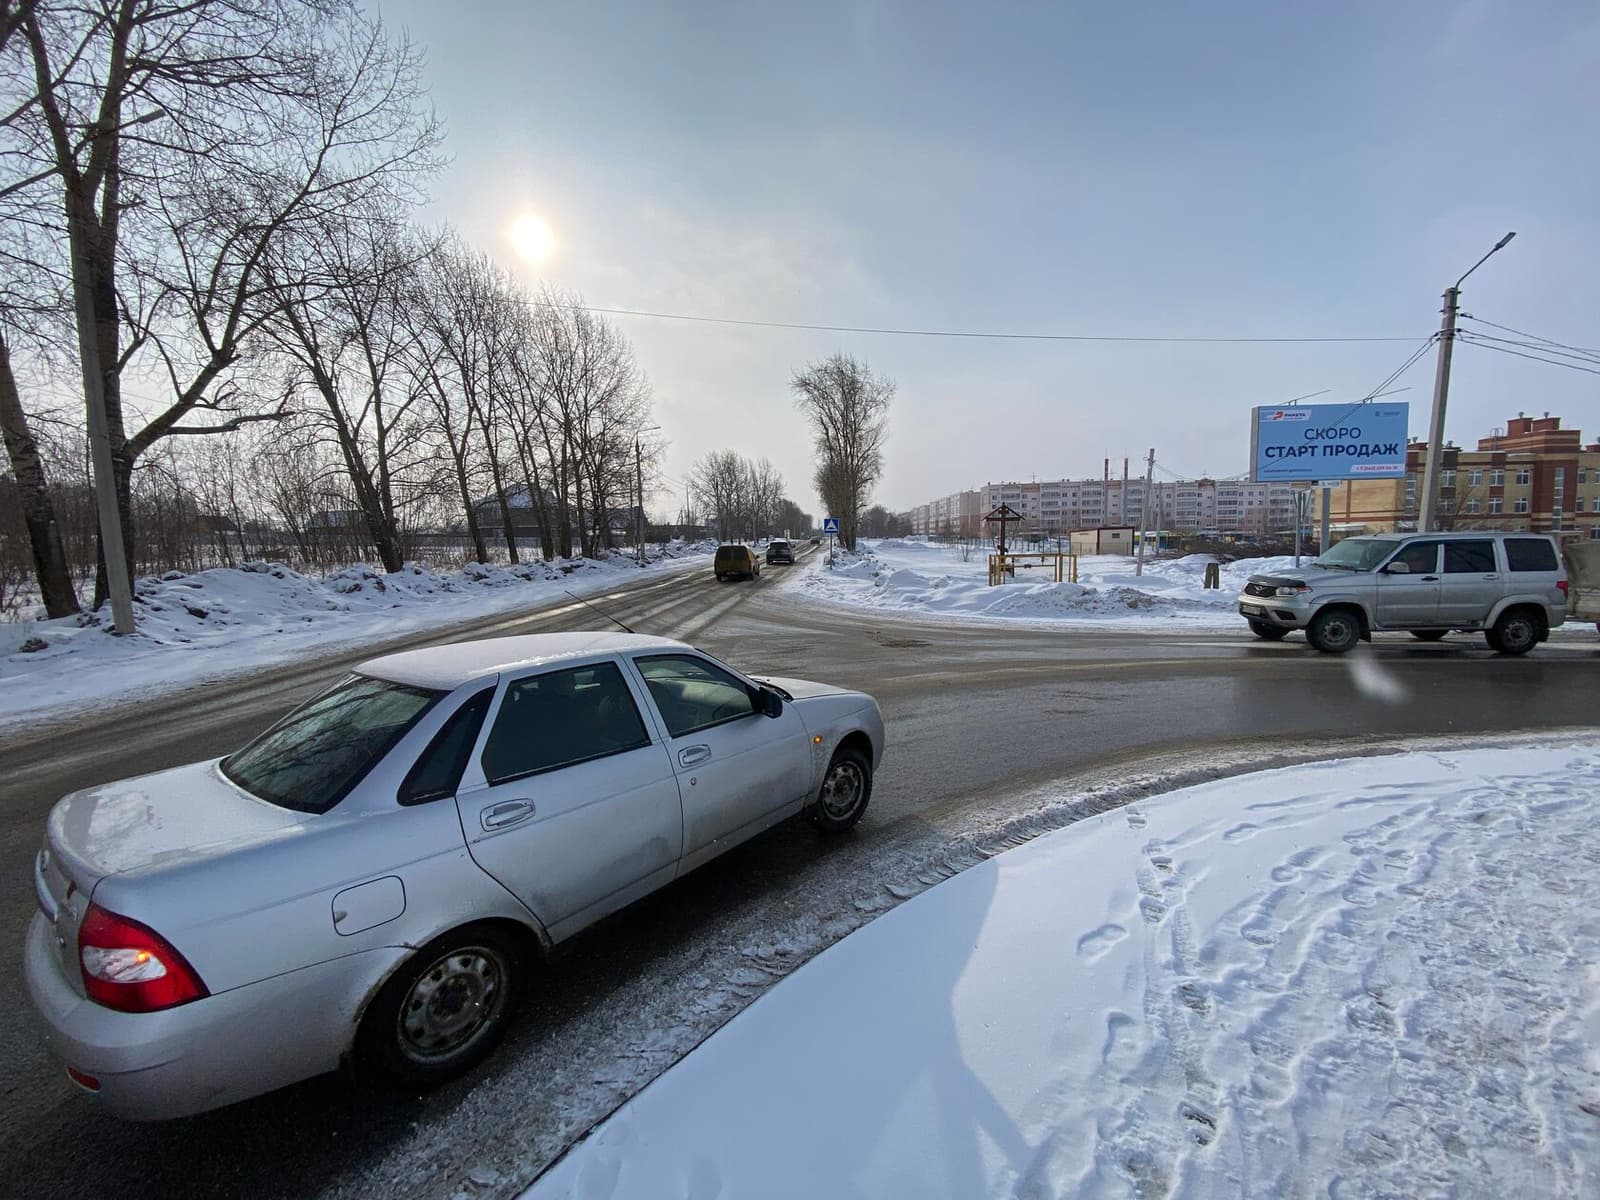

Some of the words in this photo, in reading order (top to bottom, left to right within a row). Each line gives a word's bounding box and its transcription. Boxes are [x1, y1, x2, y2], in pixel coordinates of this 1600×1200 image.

[1304, 427, 1361, 440] СКОРО
[1265, 444, 1318, 458] СТАРТ
[1323, 443, 1399, 457] ПРОДАЖ
